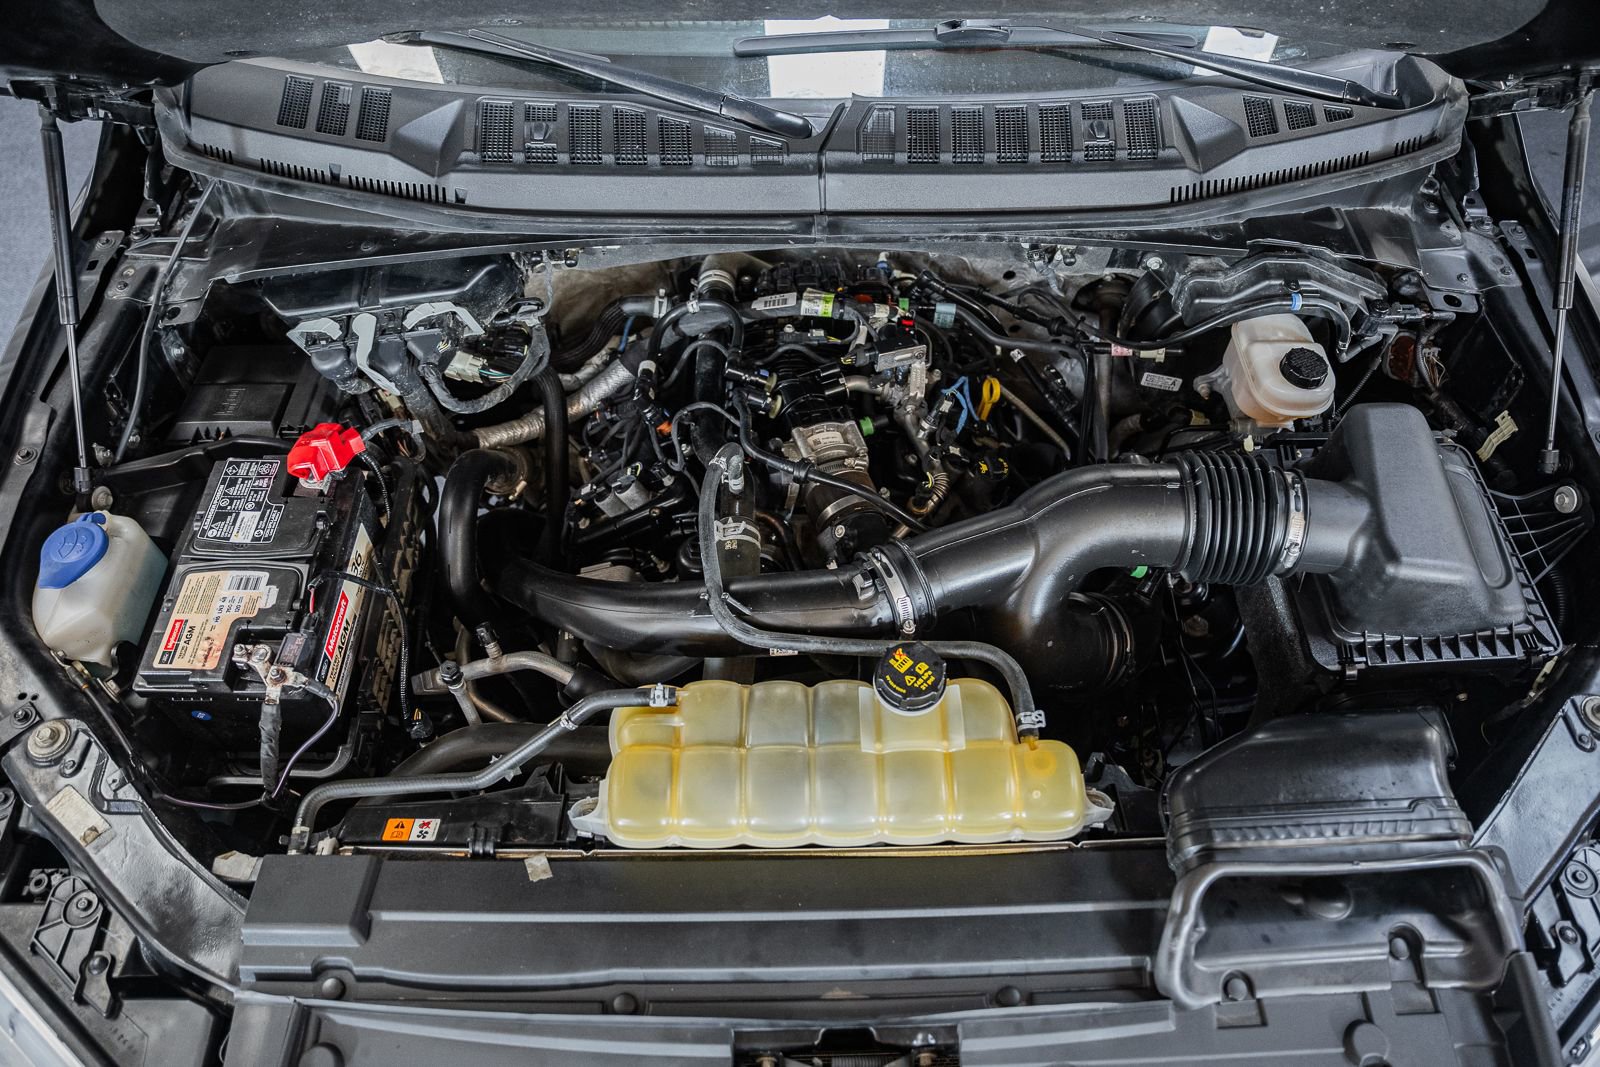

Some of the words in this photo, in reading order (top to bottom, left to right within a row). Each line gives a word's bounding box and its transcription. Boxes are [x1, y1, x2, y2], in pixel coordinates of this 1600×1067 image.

[167, 620, 182, 648] Motorcraft
[184, 625, 196, 645] AGM
[328, 599, 346, 653] Motorcraft
[337, 618, 351, 657] AGM
